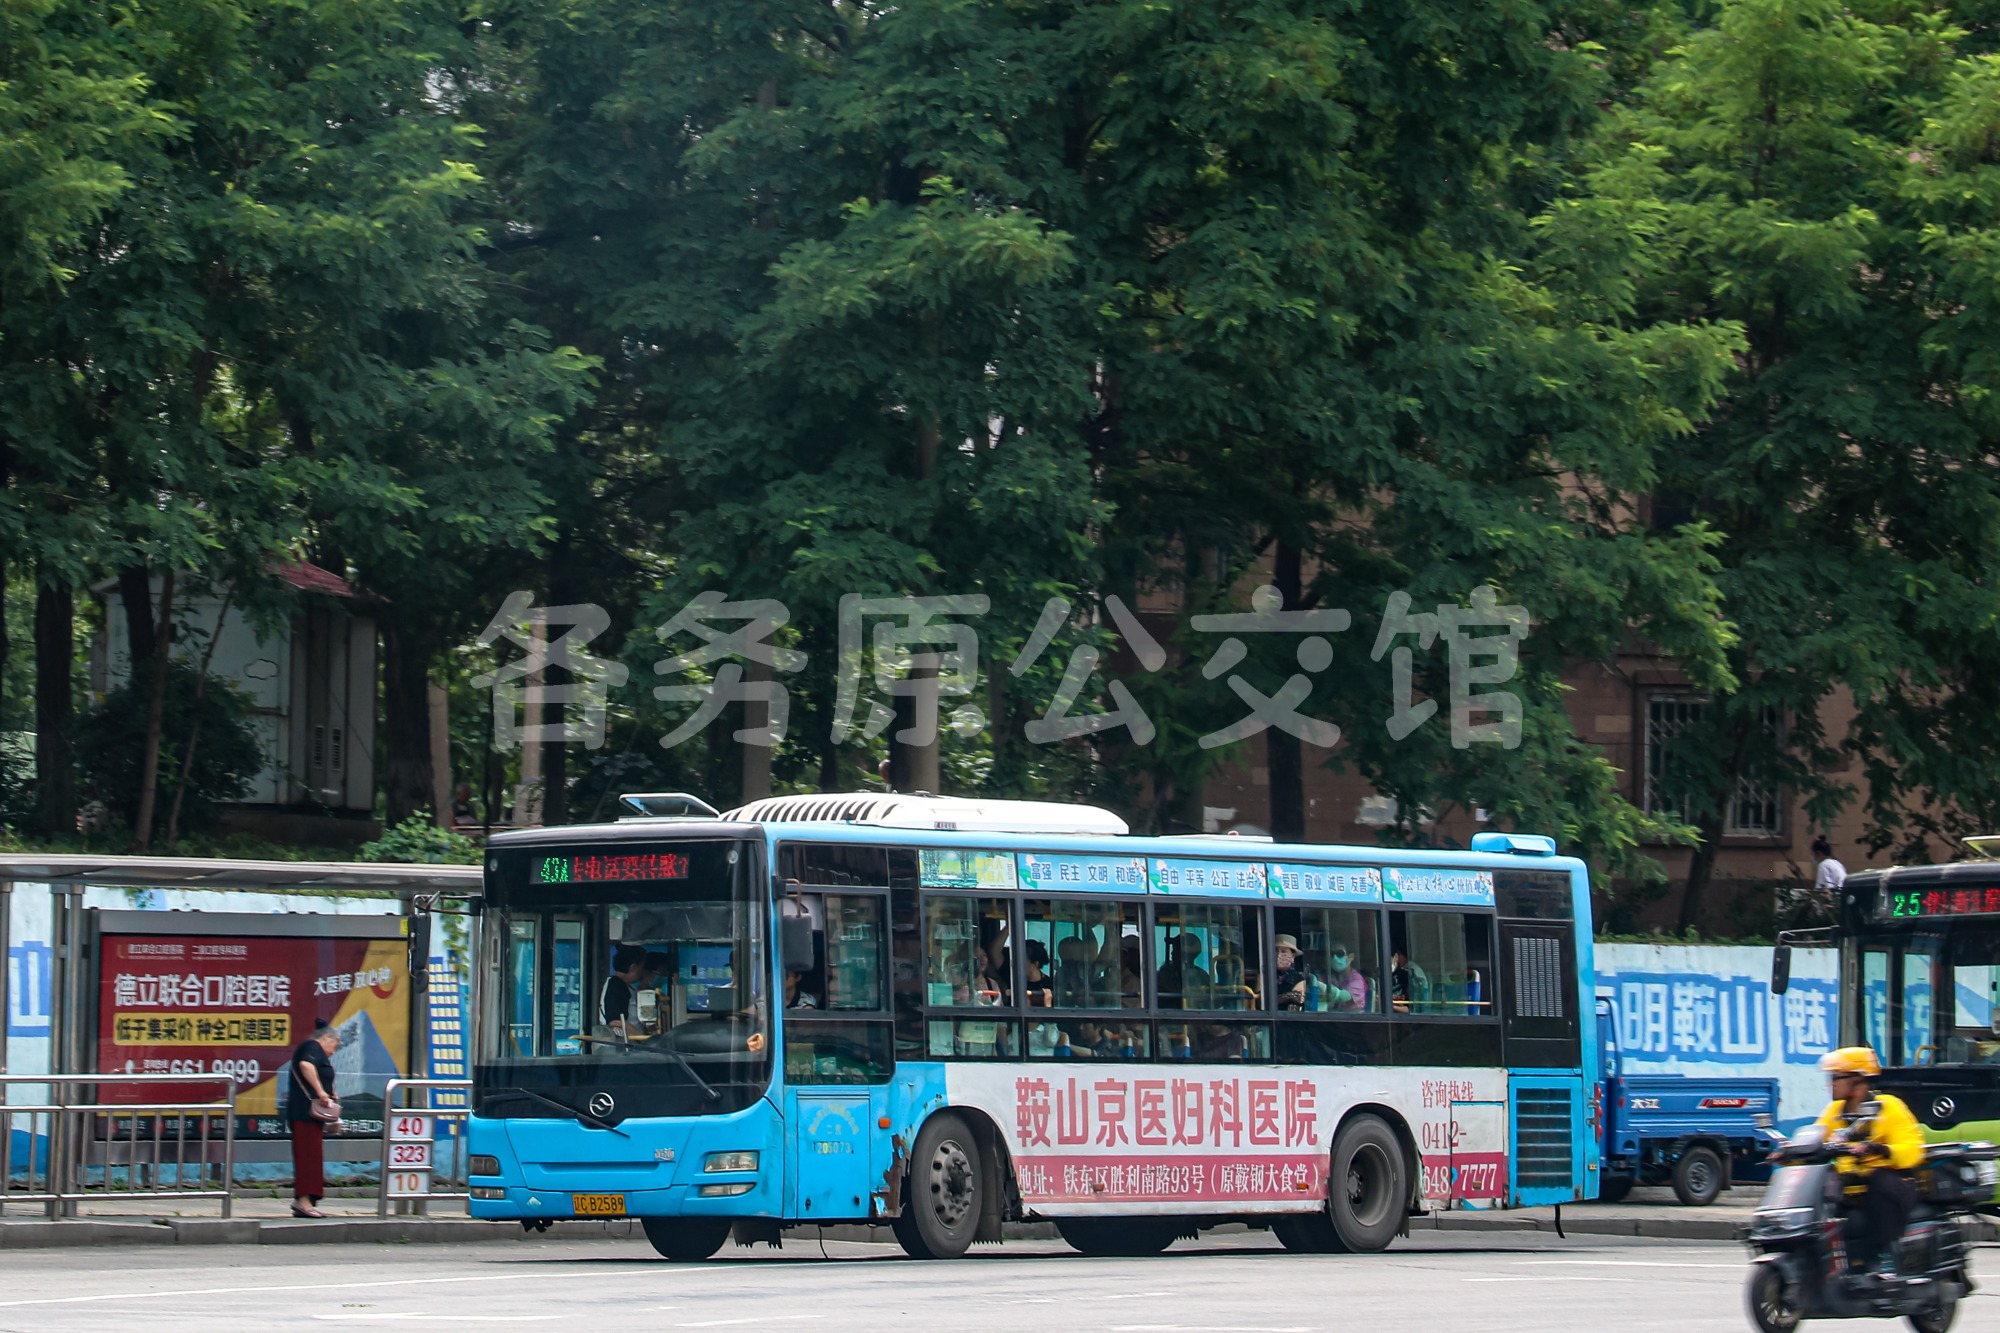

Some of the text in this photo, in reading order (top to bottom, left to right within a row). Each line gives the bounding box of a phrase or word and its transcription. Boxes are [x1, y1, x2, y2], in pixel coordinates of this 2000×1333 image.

[1030, 863, 1053, 881] 富强
[1060, 864, 1080, 882] 民主
[1088, 865, 1108, 883] 文明
[1115, 866, 1137, 885] 和谐
[1160, 868, 1254, 889] 自由 平等 公正 法治
[1282, 873, 1368, 893] 爱国 敬业 诚信 友善
[1893, 892, 1920, 916] 25
[114, 974, 291, 1007] 德立联合口腔医院
[313, 973, 352, 996] 大医院
[116, 1018, 287, 1041] 低于集采价 种全口德国牙
[1016, 1077, 1318, 1148] 鞍山京医妇科医院
[397, 1117, 423, 1135] 40
[394, 1145, 426, 1163] 323
[395, 1173, 420, 1191] 10
